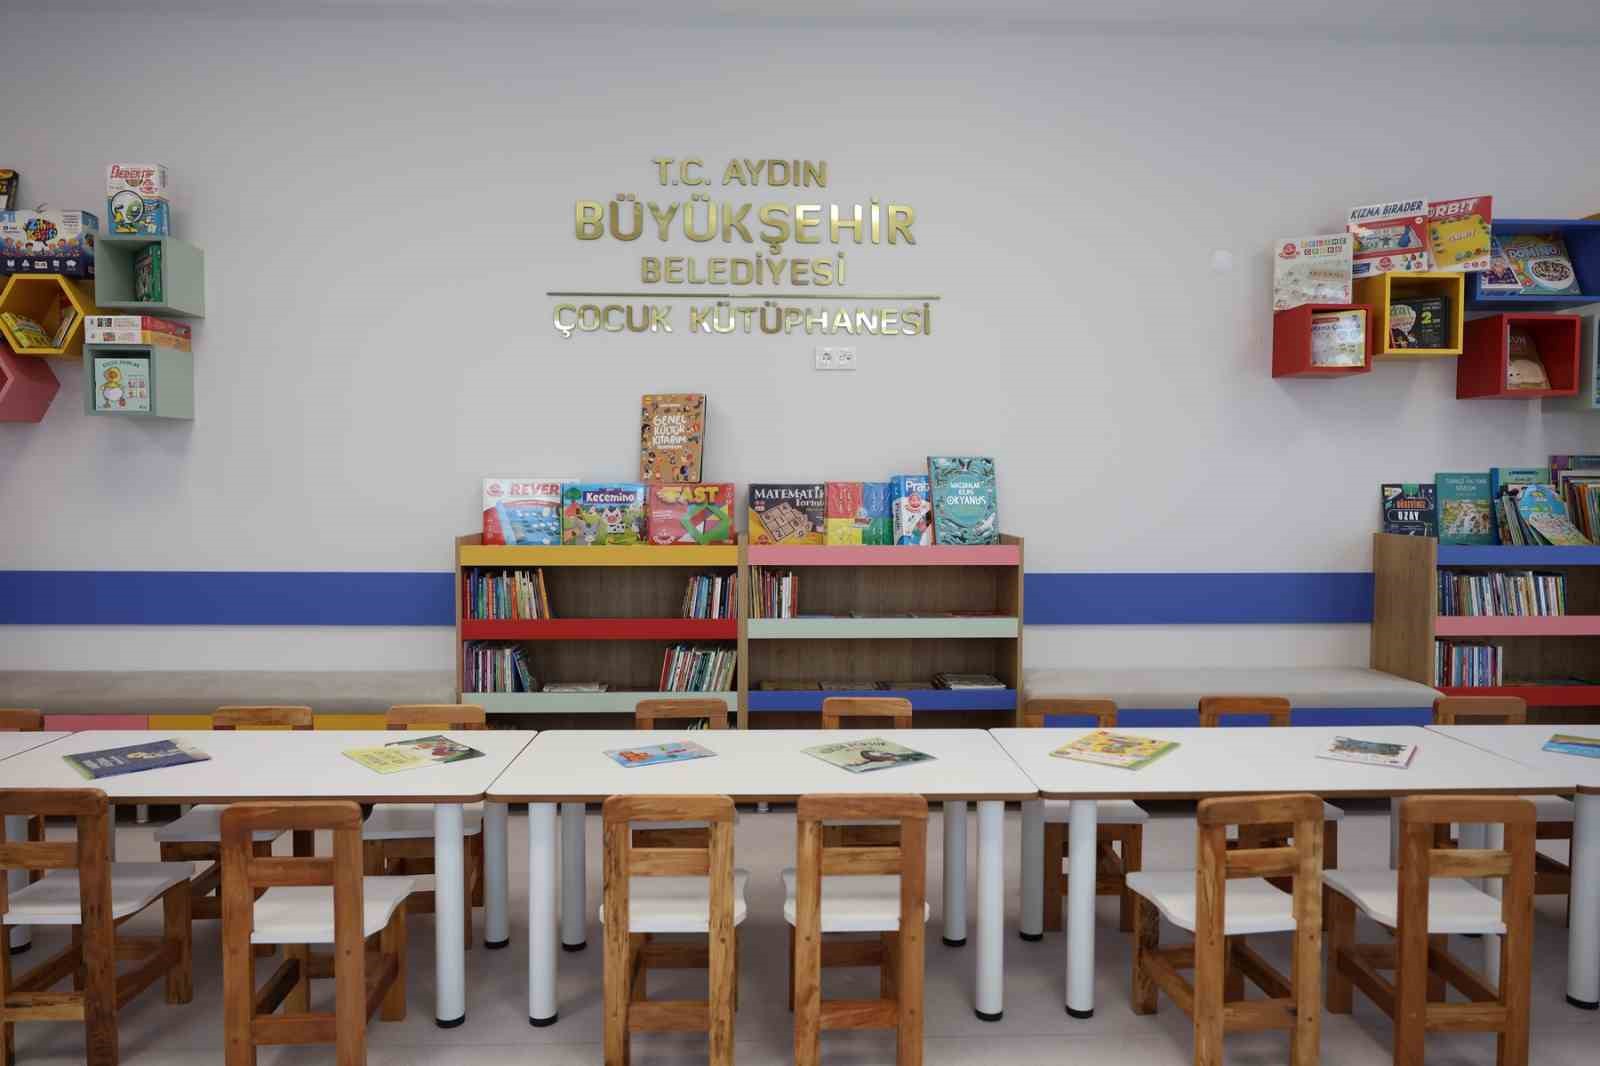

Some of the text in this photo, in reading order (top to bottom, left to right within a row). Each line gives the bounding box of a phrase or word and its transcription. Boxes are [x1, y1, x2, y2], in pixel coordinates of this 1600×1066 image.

[653, 158, 828, 188] T.C. AYDIN
[575, 193, 916, 255] BÜYÜKŞEHİR
[641, 251, 847, 286] BELEDİYESİ
[553, 301, 932, 338] ÇOCUK KÜTÜPHANESİ
